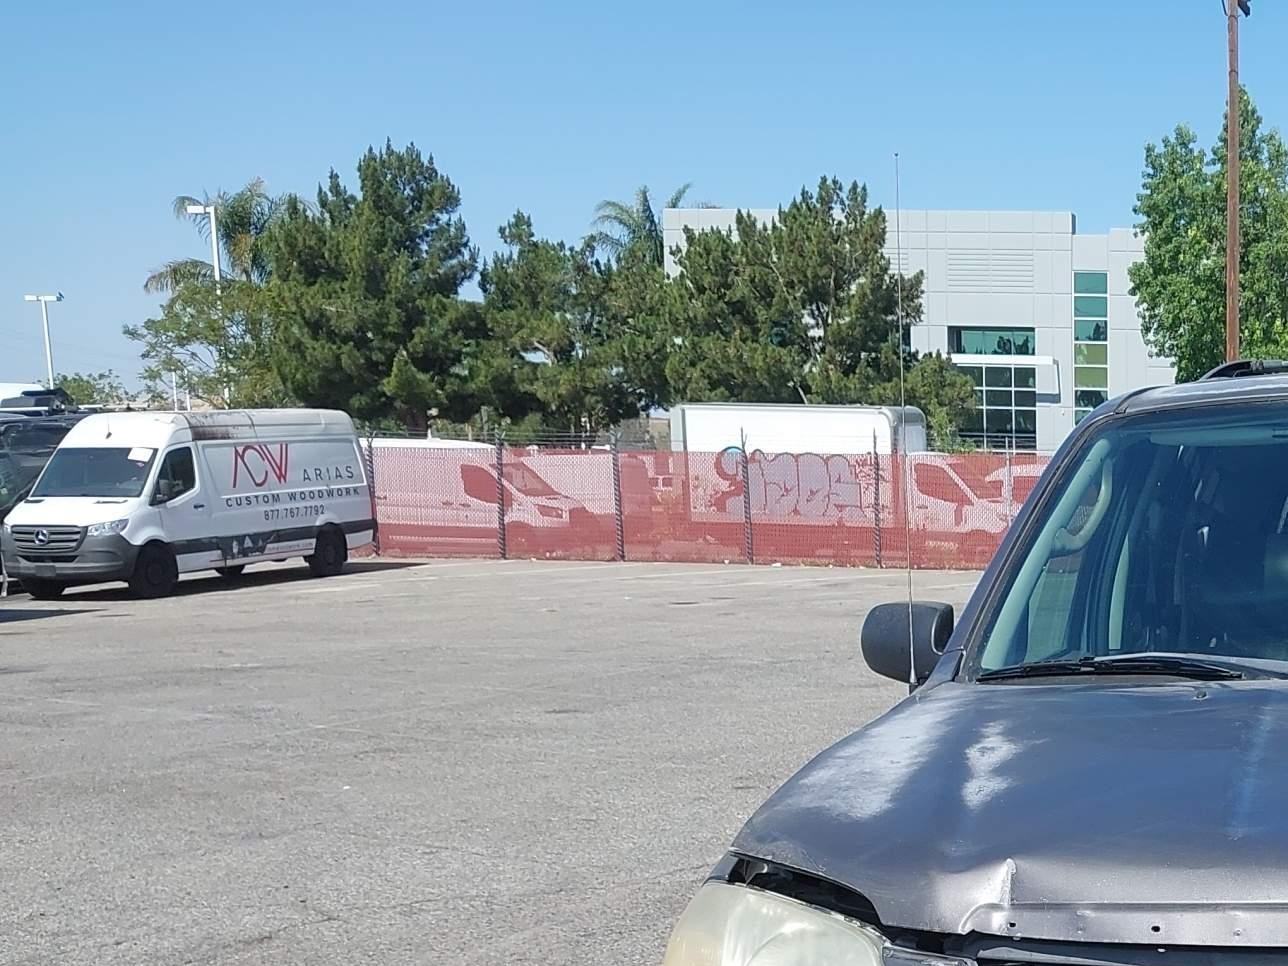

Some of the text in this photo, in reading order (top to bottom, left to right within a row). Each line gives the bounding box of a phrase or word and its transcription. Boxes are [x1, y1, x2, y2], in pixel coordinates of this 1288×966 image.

[303, 465, 354, 482] ARIAS
[225, 486, 360, 507] CUSTOM WOODWORK
[264, 504, 325, 520] 877.767.7792
